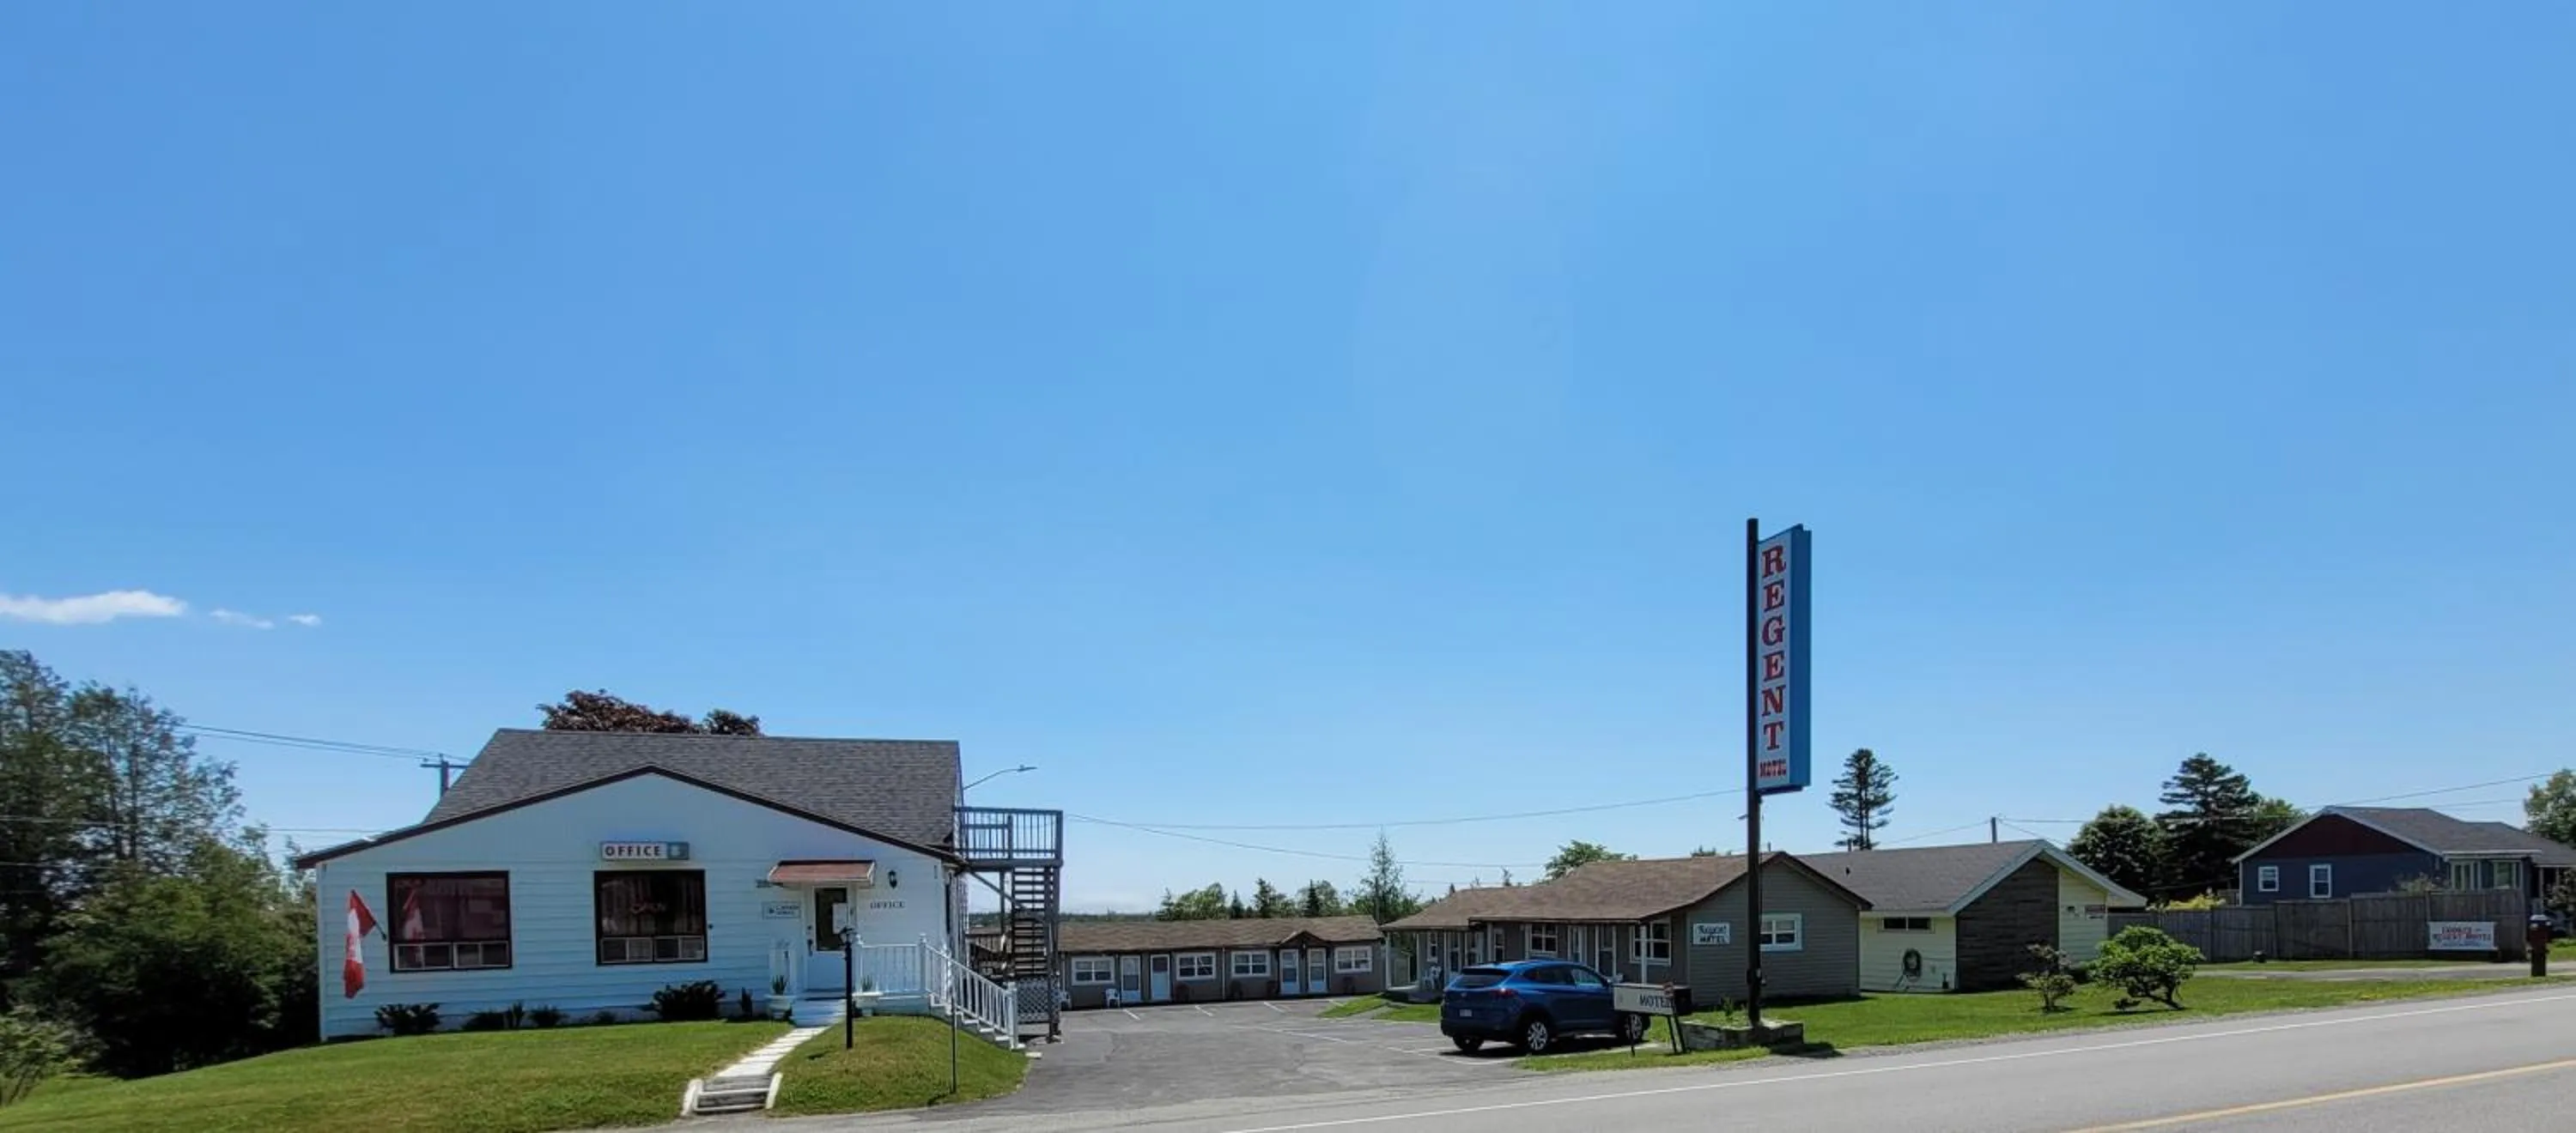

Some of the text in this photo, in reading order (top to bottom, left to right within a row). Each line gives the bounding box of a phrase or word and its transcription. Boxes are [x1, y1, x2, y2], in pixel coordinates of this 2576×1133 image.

[1762, 545, 1786, 751] REGENT
[1760, 759, 1787, 778] MOTEL
[605, 845, 660, 857] OFFICE
[869, 901, 906, 910] OFFICE
[1639, 994, 1674, 1009] MOTEL
